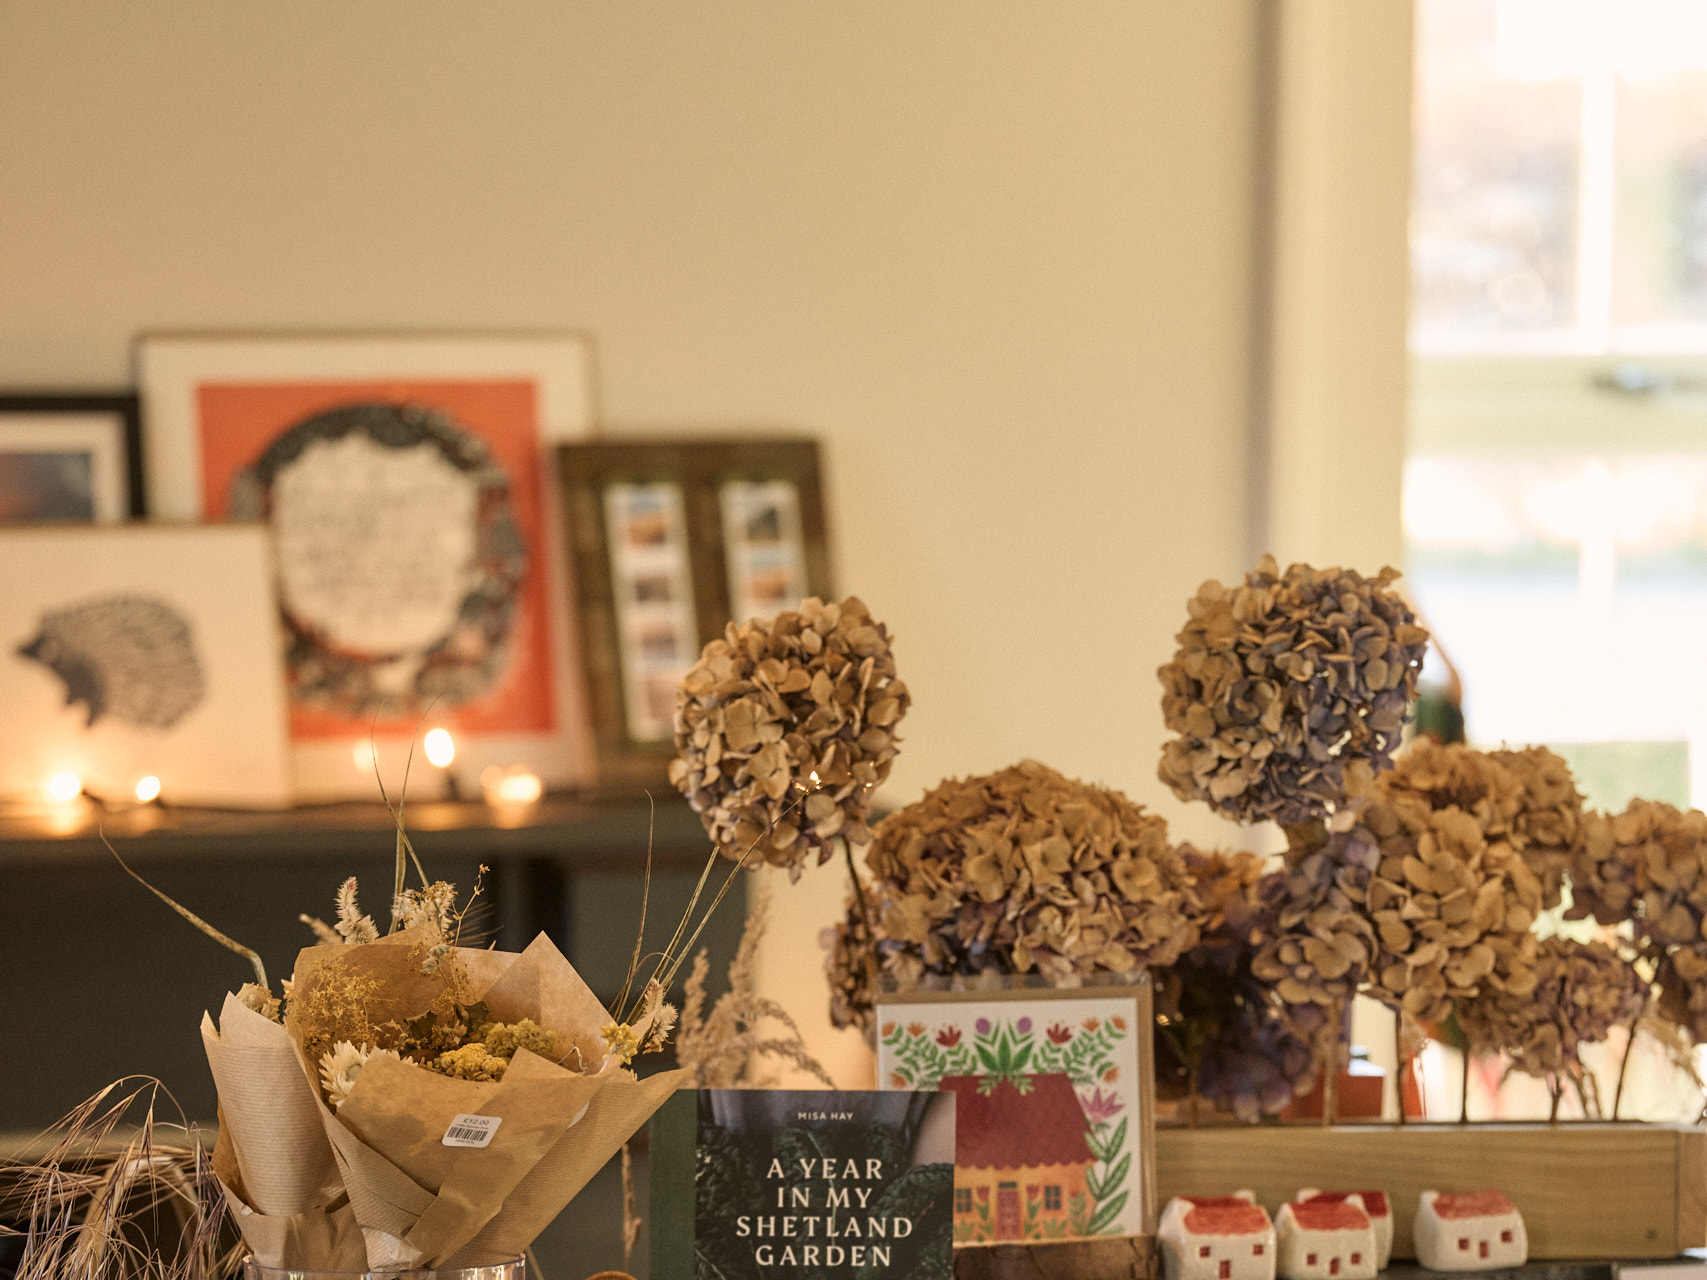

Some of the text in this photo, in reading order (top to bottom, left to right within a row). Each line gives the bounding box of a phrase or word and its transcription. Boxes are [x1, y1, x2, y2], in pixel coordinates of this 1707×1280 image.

[798, 1112, 853, 1121] MISA HAY
[766, 1158, 882, 1180] A YEAR
[777, 1187, 872, 1209] IN MY
[736, 1216, 913, 1238] SHETLAND
[755, 1245, 891, 1267] GARDEN
